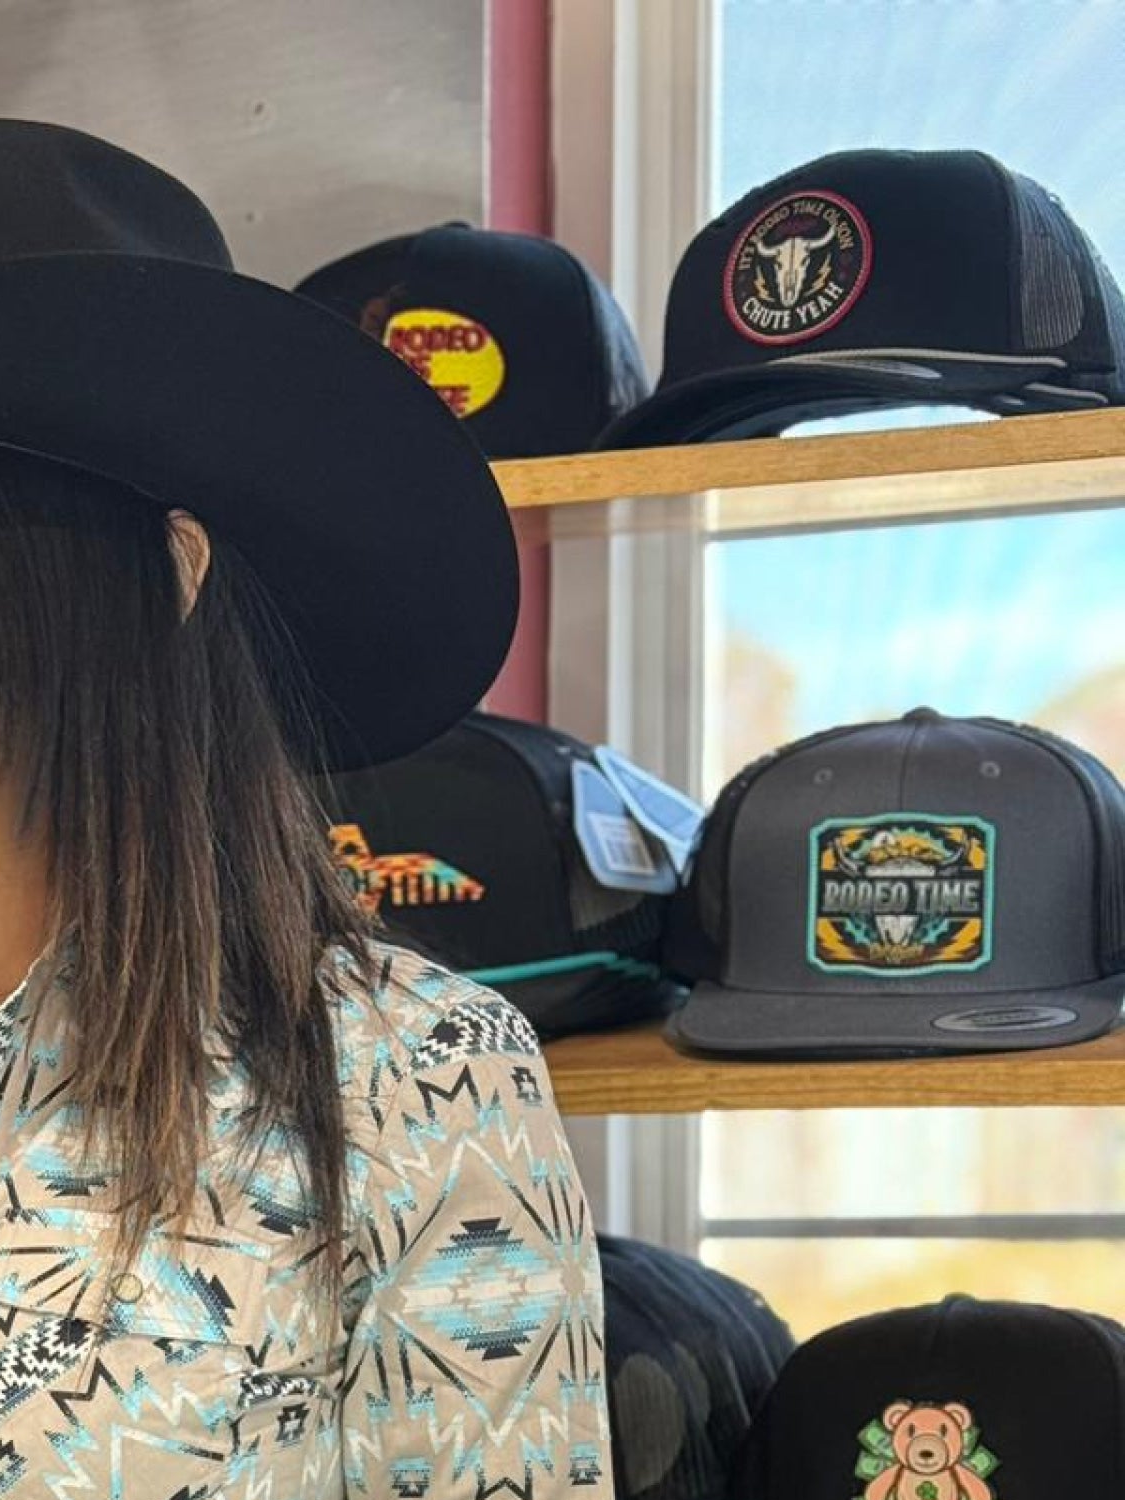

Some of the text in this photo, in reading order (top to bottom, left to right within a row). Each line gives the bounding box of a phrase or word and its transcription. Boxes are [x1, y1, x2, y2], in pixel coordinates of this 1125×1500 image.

[742, 281, 845, 329] CHUTE YEAH
[389, 325, 489, 353] RODEO
[823, 880, 981, 914] RODEO TIME
